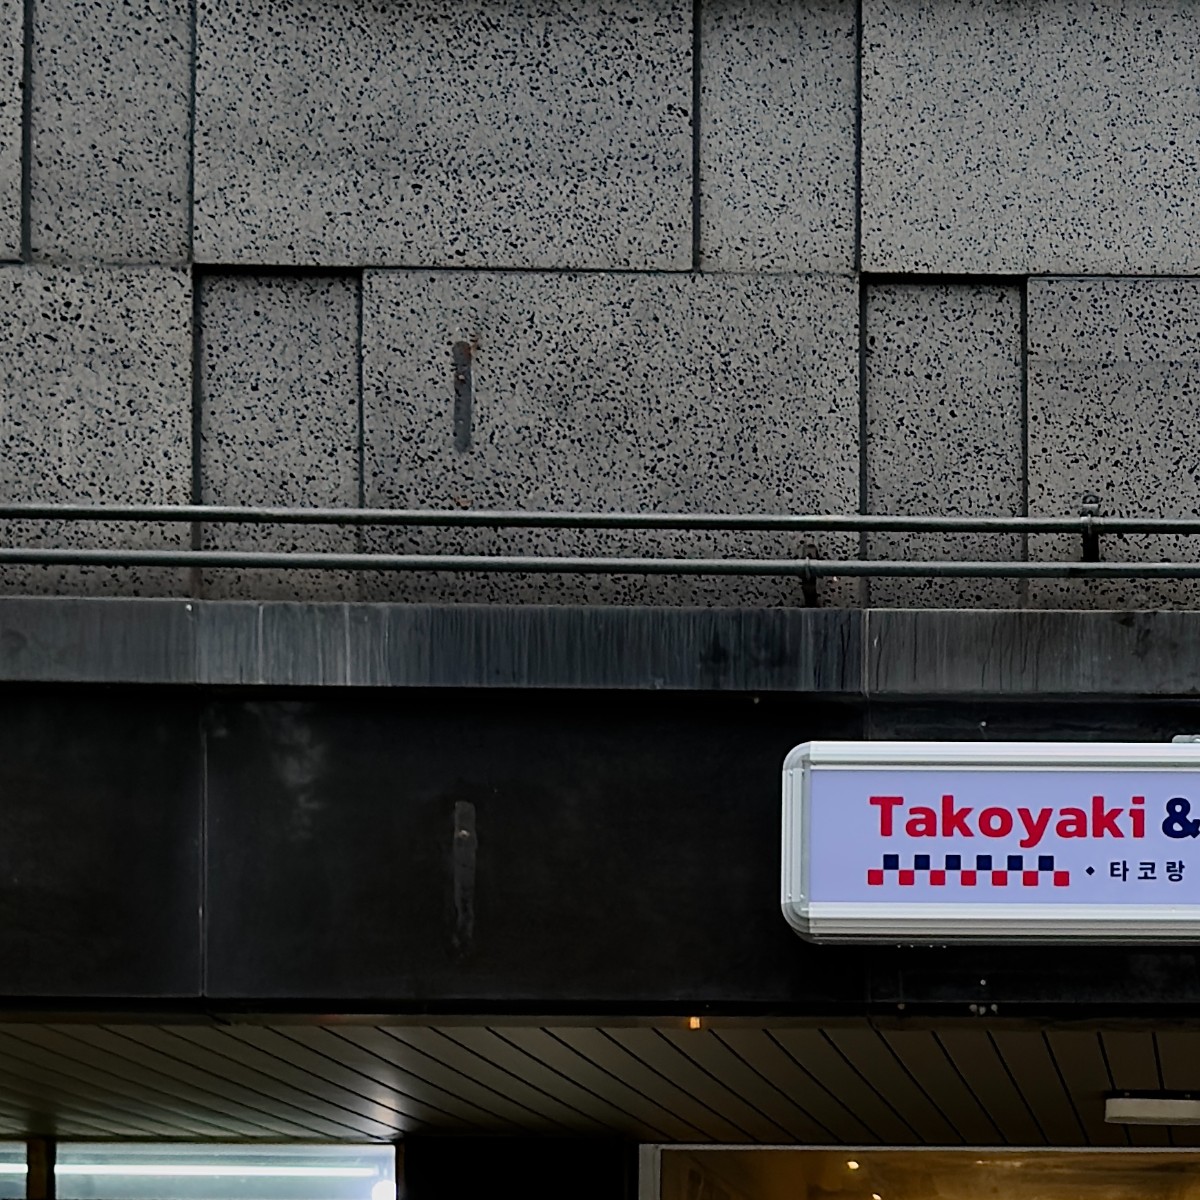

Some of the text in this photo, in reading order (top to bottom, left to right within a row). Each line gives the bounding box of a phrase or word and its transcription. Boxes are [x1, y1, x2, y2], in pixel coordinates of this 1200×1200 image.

[869, 795, 1145, 848] Takoyaki
[1161, 797, 1200, 839] &
[1109, 861, 1186, 882] 타코랑
